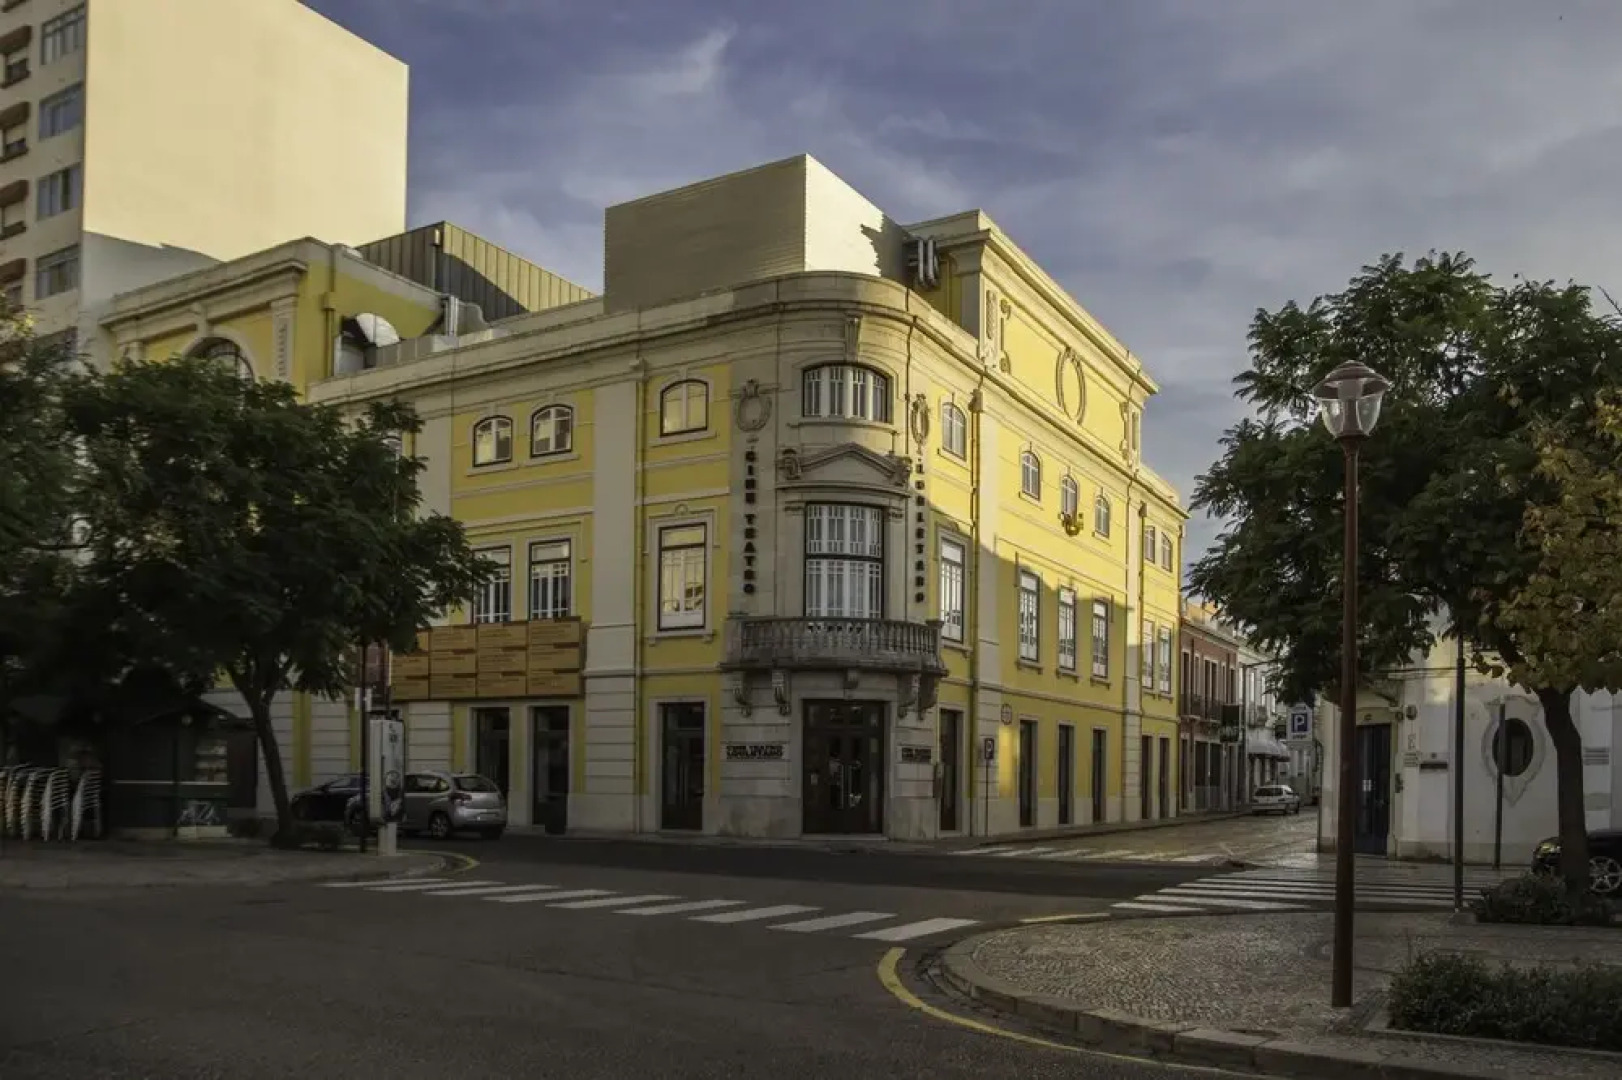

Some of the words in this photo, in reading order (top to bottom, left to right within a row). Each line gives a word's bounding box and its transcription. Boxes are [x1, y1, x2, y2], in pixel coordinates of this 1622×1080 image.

[743, 513, 757, 595] TEATRO
[914, 463, 926, 604] LOULETANO
[1293, 714, 1305, 732] P
